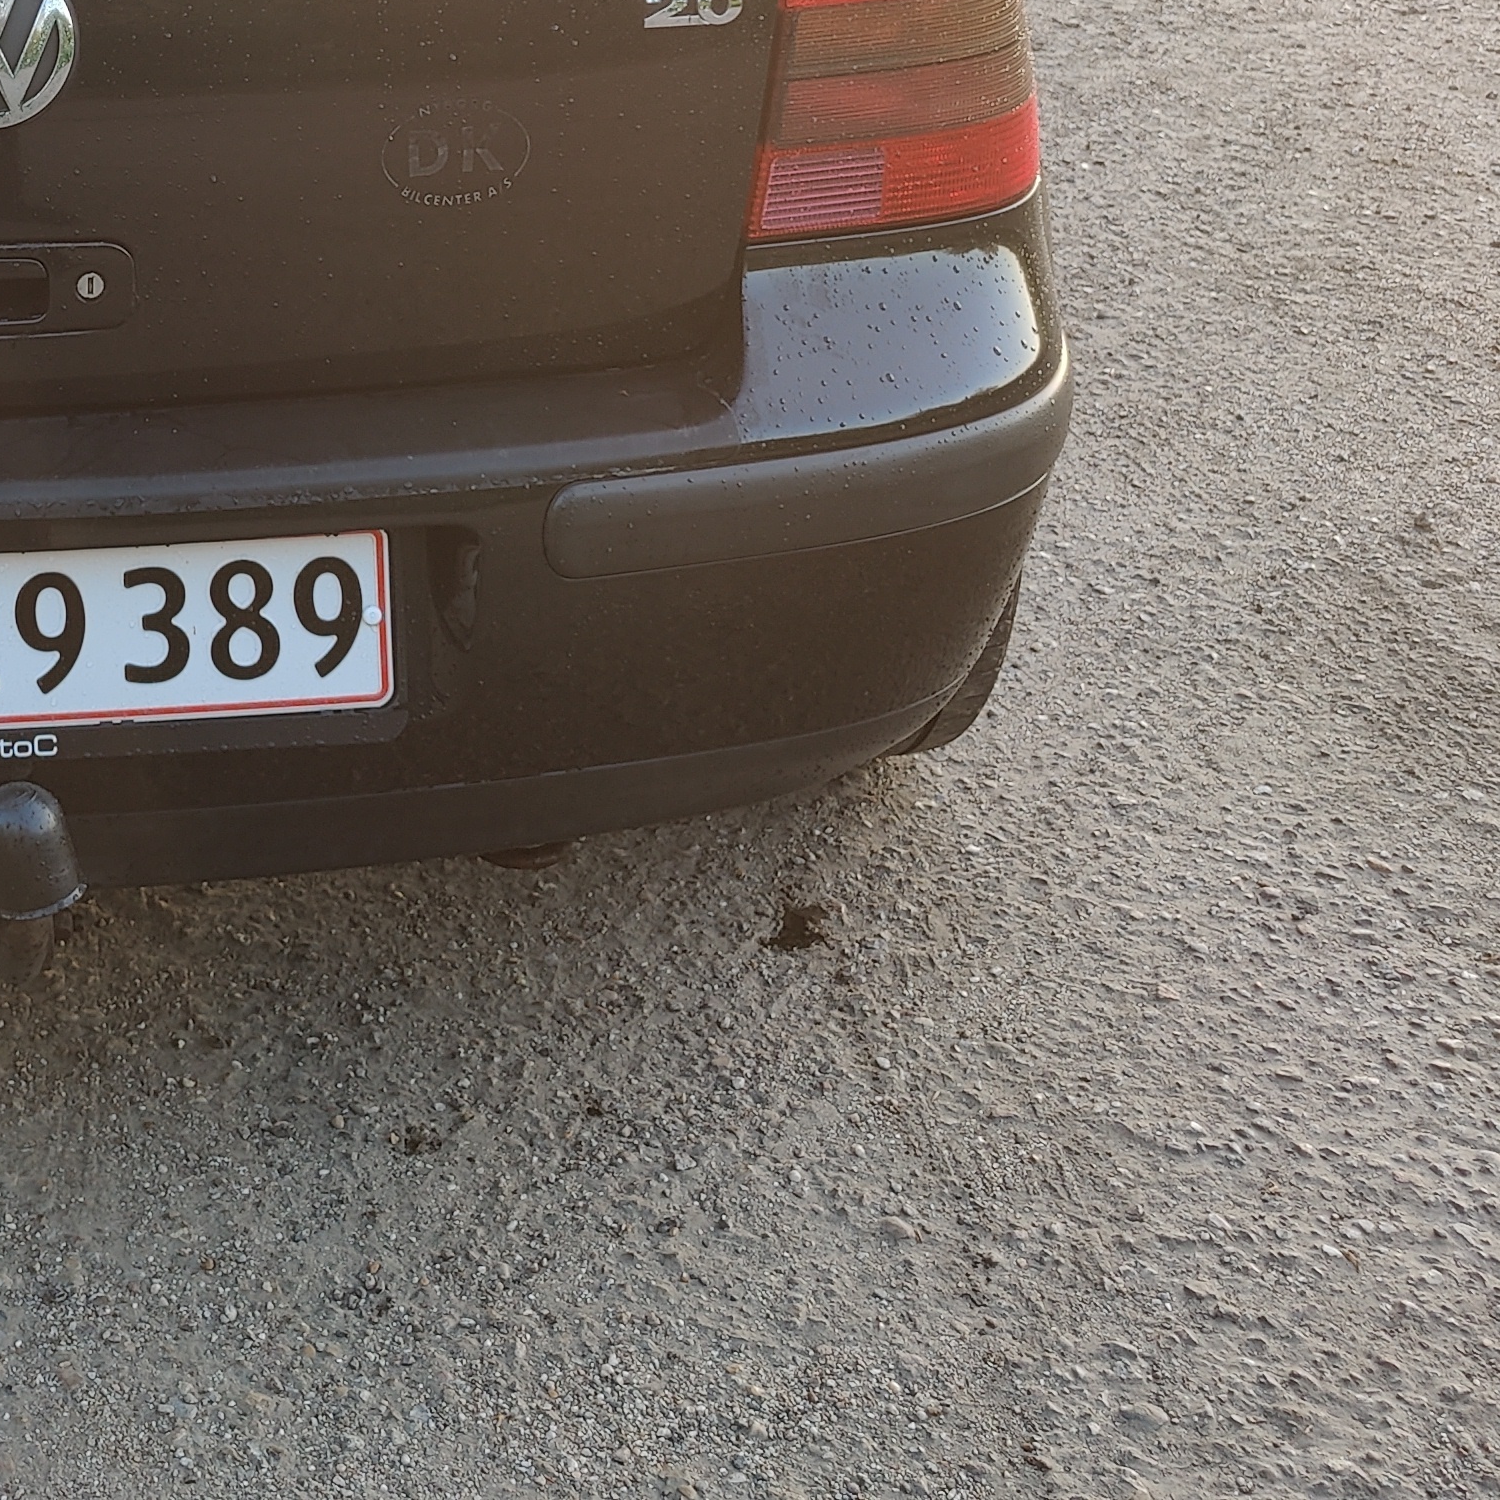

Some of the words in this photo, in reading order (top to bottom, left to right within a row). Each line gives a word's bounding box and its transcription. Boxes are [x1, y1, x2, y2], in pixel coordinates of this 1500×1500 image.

[408, 122, 505, 178] DK
[400, 185, 482, 206] BILCENTER
[122, 557, 364, 685] 389
